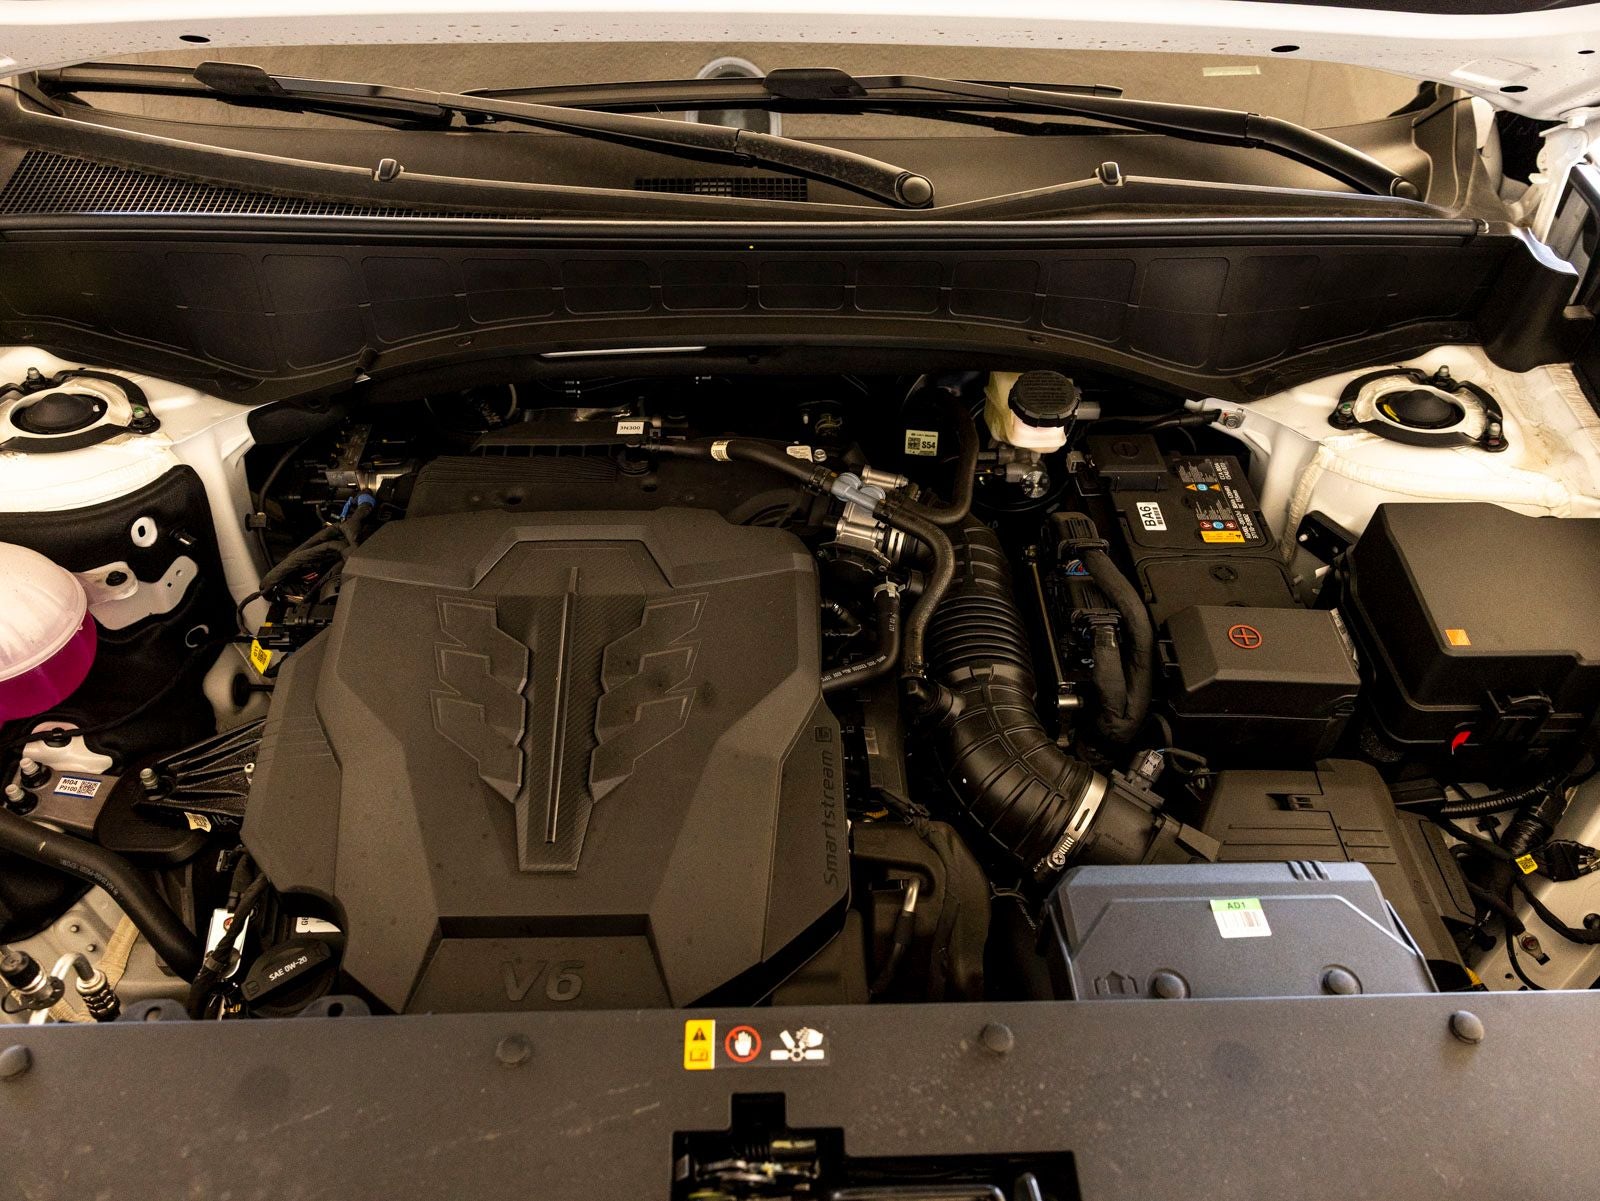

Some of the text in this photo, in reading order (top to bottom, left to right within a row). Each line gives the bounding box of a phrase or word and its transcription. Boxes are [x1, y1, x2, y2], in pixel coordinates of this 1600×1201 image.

[921, 440, 936, 449] S54
[1139, 506, 1157, 526] BA6
[820, 750, 838, 887] Smartstream
[1227, 901, 1246, 910] AD1
[268, 955, 308, 981] SAE 0W-20
[500, 960, 585, 1002] V6
